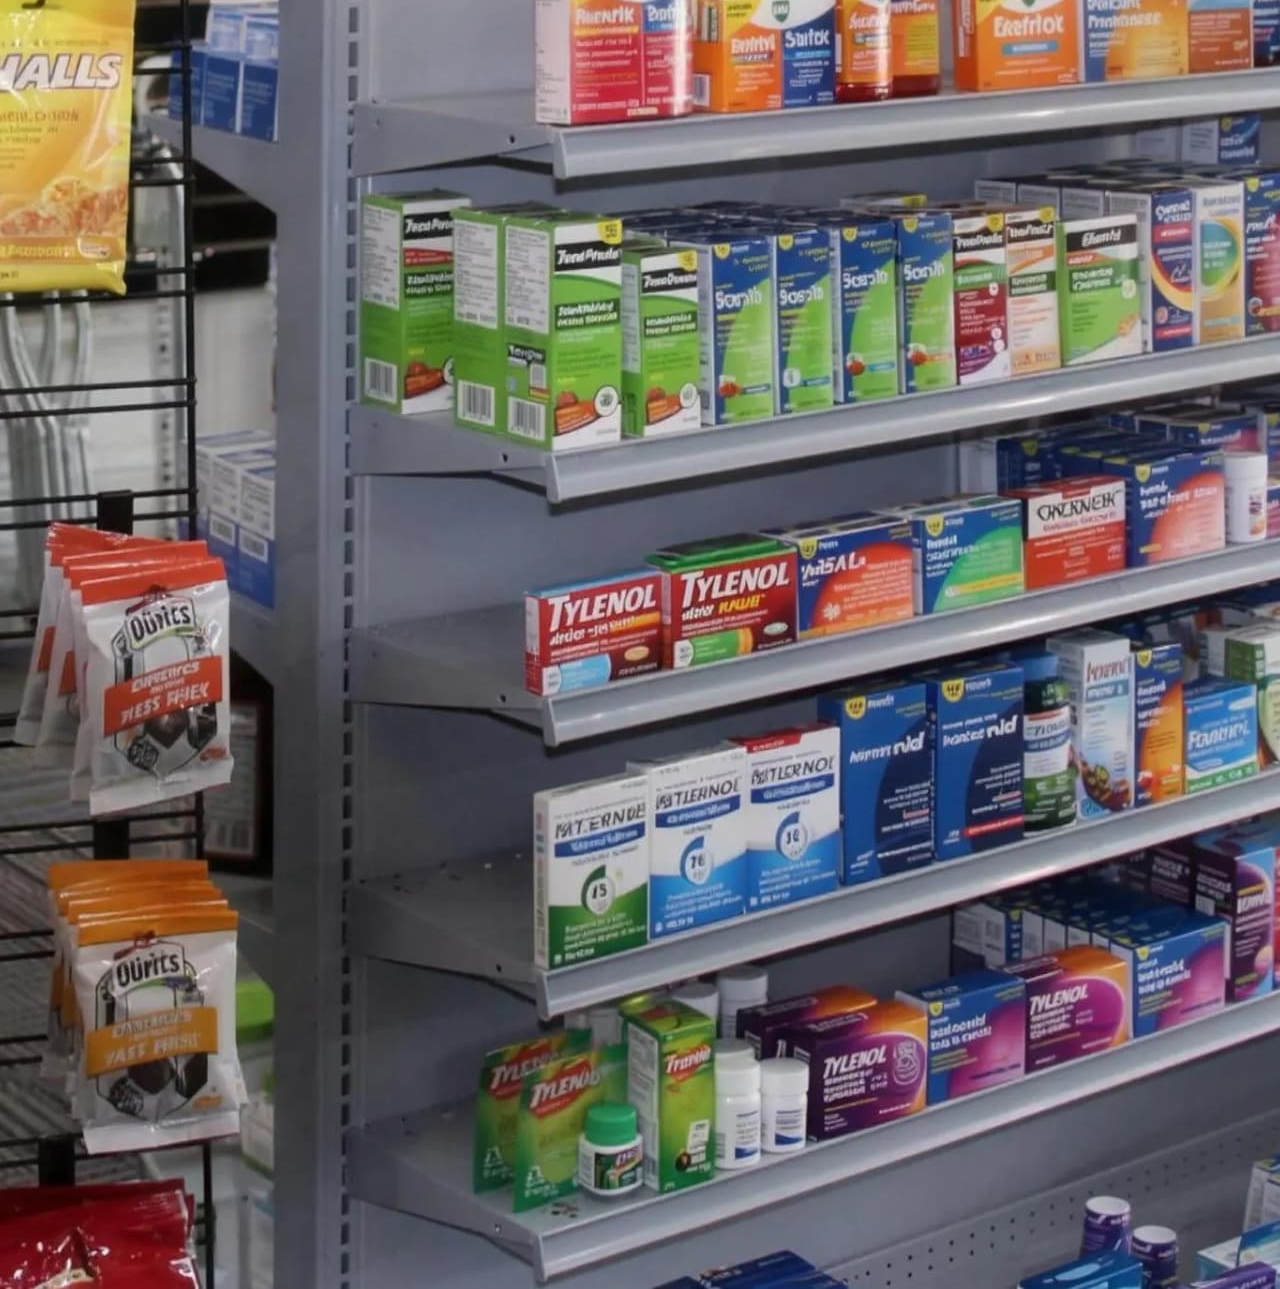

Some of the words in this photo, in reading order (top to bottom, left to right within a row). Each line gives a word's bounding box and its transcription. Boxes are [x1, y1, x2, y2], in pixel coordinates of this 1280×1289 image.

[547, 584, 656, 632] TYLENOL
[680, 561, 790, 608] TYLENOL
[1029, 983, 1089, 1015] TYLENOL
